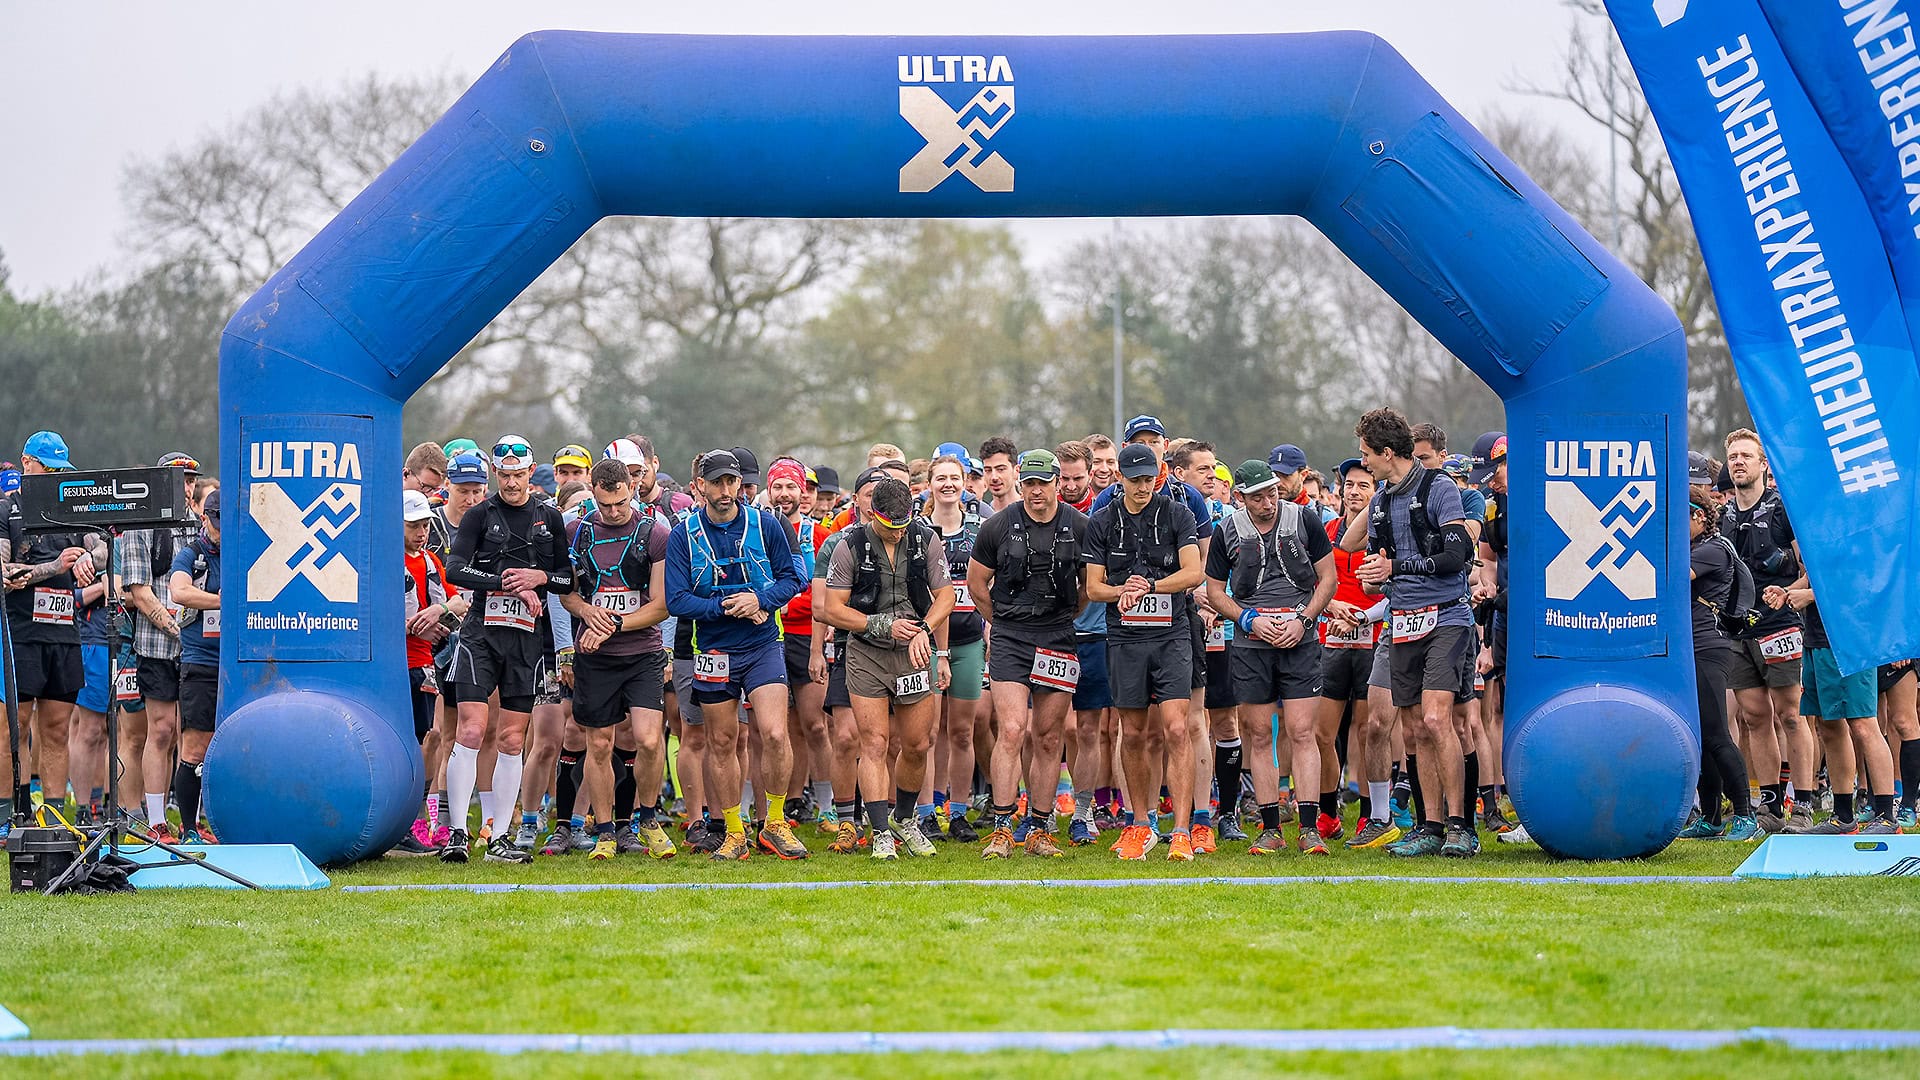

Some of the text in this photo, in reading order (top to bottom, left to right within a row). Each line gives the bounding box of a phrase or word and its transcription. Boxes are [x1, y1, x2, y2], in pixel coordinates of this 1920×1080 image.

[898, 55, 1015, 82] ULTRA
[1697, 33, 1899, 494] #THEULTRAXPERIENCE
[250, 441, 362, 480] ULTRA
[1545, 440, 1657, 477] ULTRA
[63, 484, 113, 498] RESULTSBASE
[48, 595, 66, 613] 268
[501, 598, 521, 616] 541
[247, 611, 359, 635] #theultraXperience
[1405, 615, 1424, 633] 567
[1545, 608, 1657, 634] #theultraXperience
[1774, 636, 1795, 655] 335
[696, 655, 714, 674] 525
[1047, 659, 1067, 678] 853
[902, 675, 923, 694] 848
